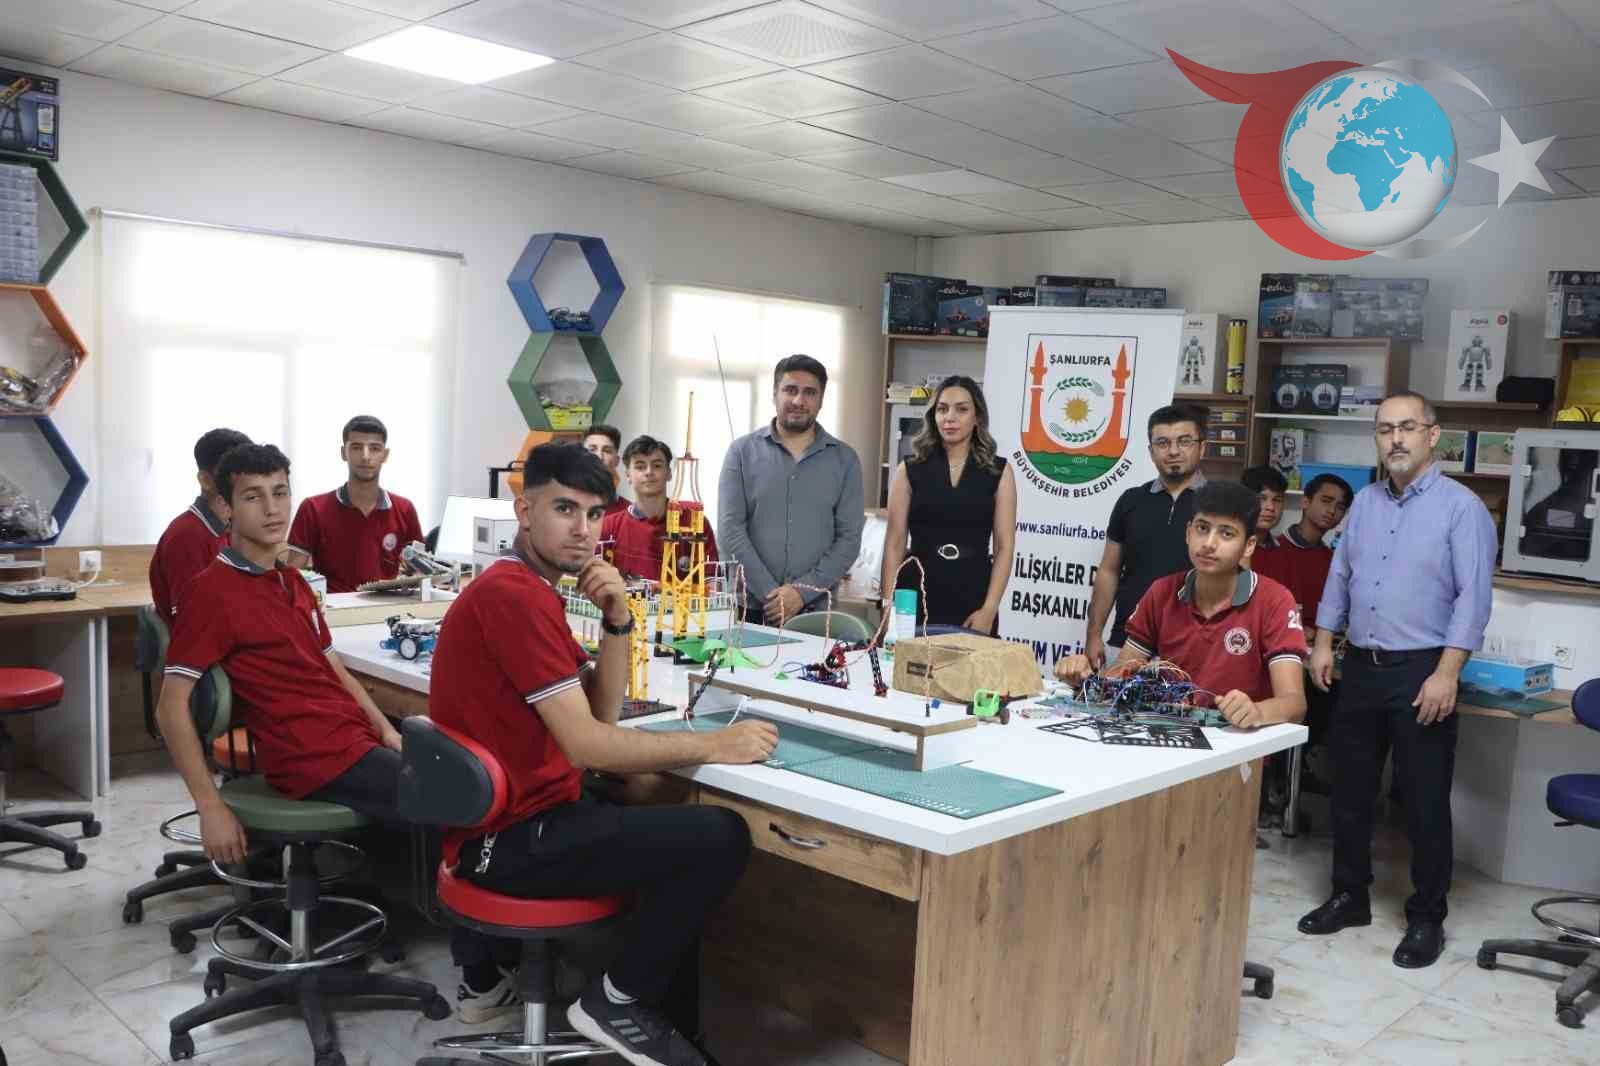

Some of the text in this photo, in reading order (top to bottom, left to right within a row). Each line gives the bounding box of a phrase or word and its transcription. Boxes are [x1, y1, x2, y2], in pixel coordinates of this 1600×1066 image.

[1050, 354, 1111, 366] ŞANLIURFA
[1013, 451, 1133, 498] BÜYÜKŞEHİR BELEDİYESİ
[1016, 521, 1106, 540] ww.sanliurfa.be
[1015, 552, 1085, 585] İLİŞKİLER
